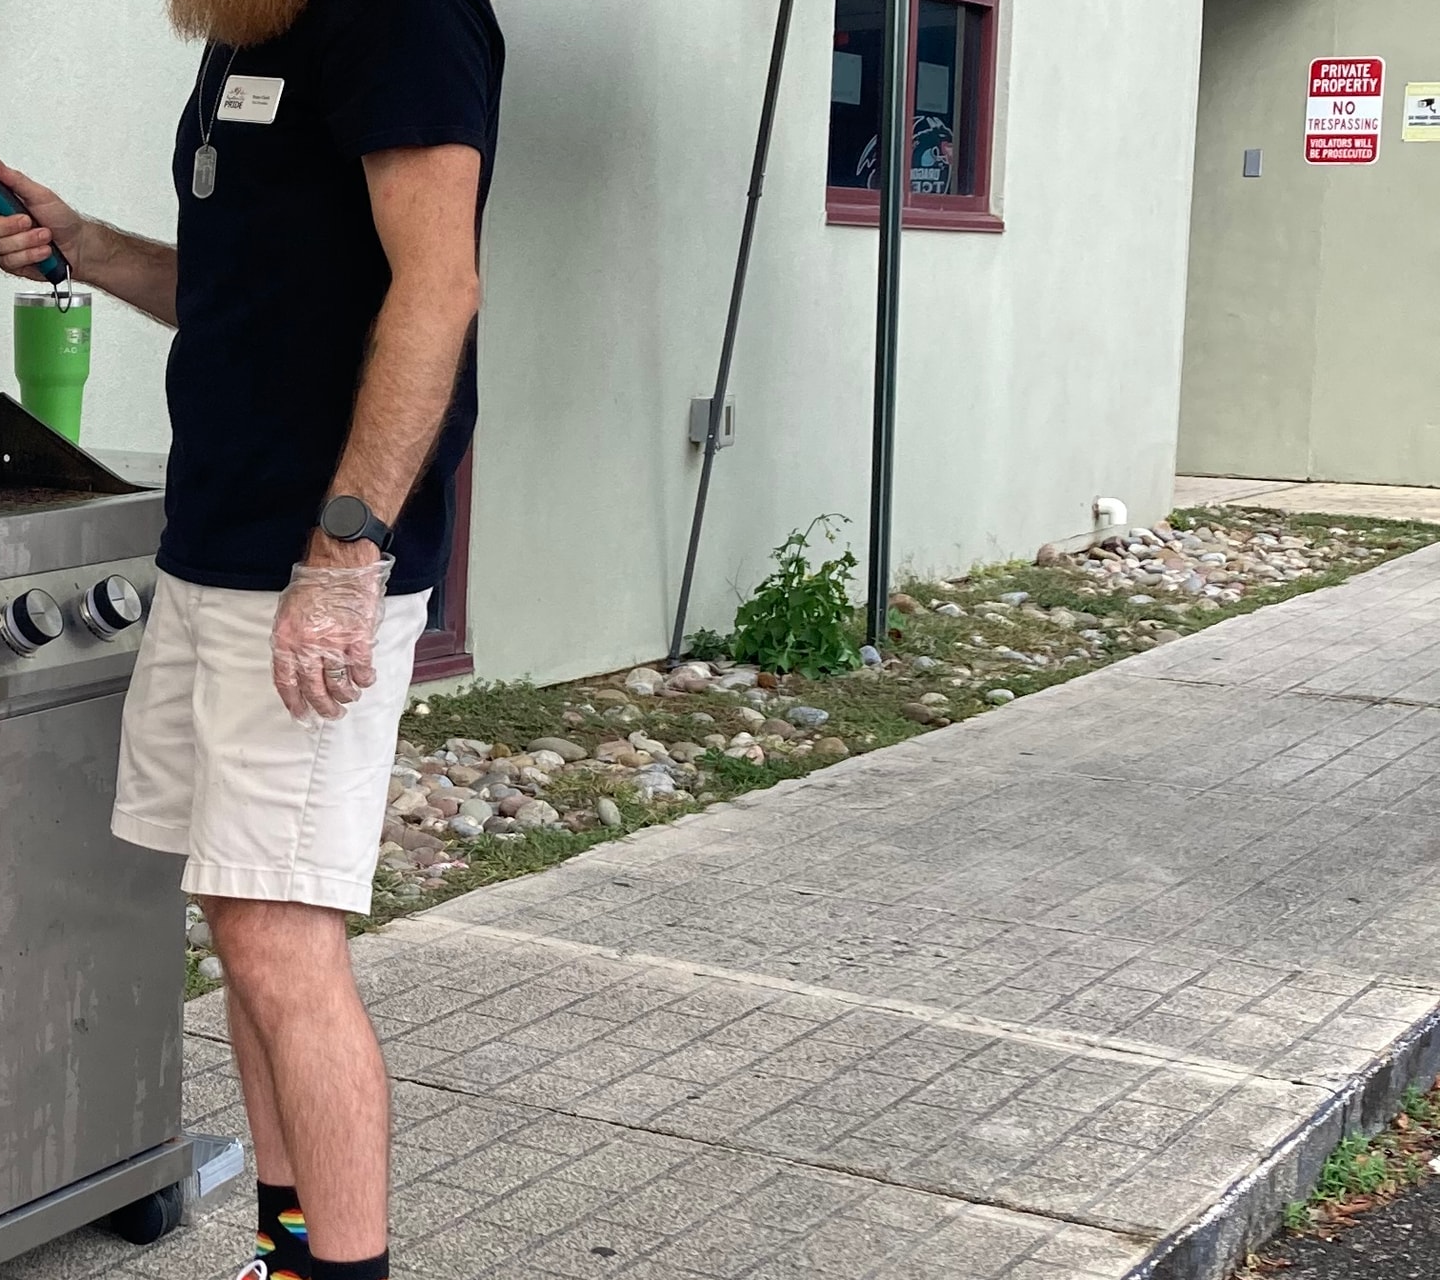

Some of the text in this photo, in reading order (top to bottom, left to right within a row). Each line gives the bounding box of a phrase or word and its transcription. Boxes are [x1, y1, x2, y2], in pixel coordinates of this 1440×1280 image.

[1321, 63, 1371, 78] PRIVATE
[1312, 78, 1378, 93] PROPERTY
[1333, 101, 1356, 115] NO
[1308, 118, 1378, 131] TRESPASSING
[1310, 138, 1373, 148] VIOLATORS WILL
[1309, 148, 1373, 159] BE PROSECUTED
